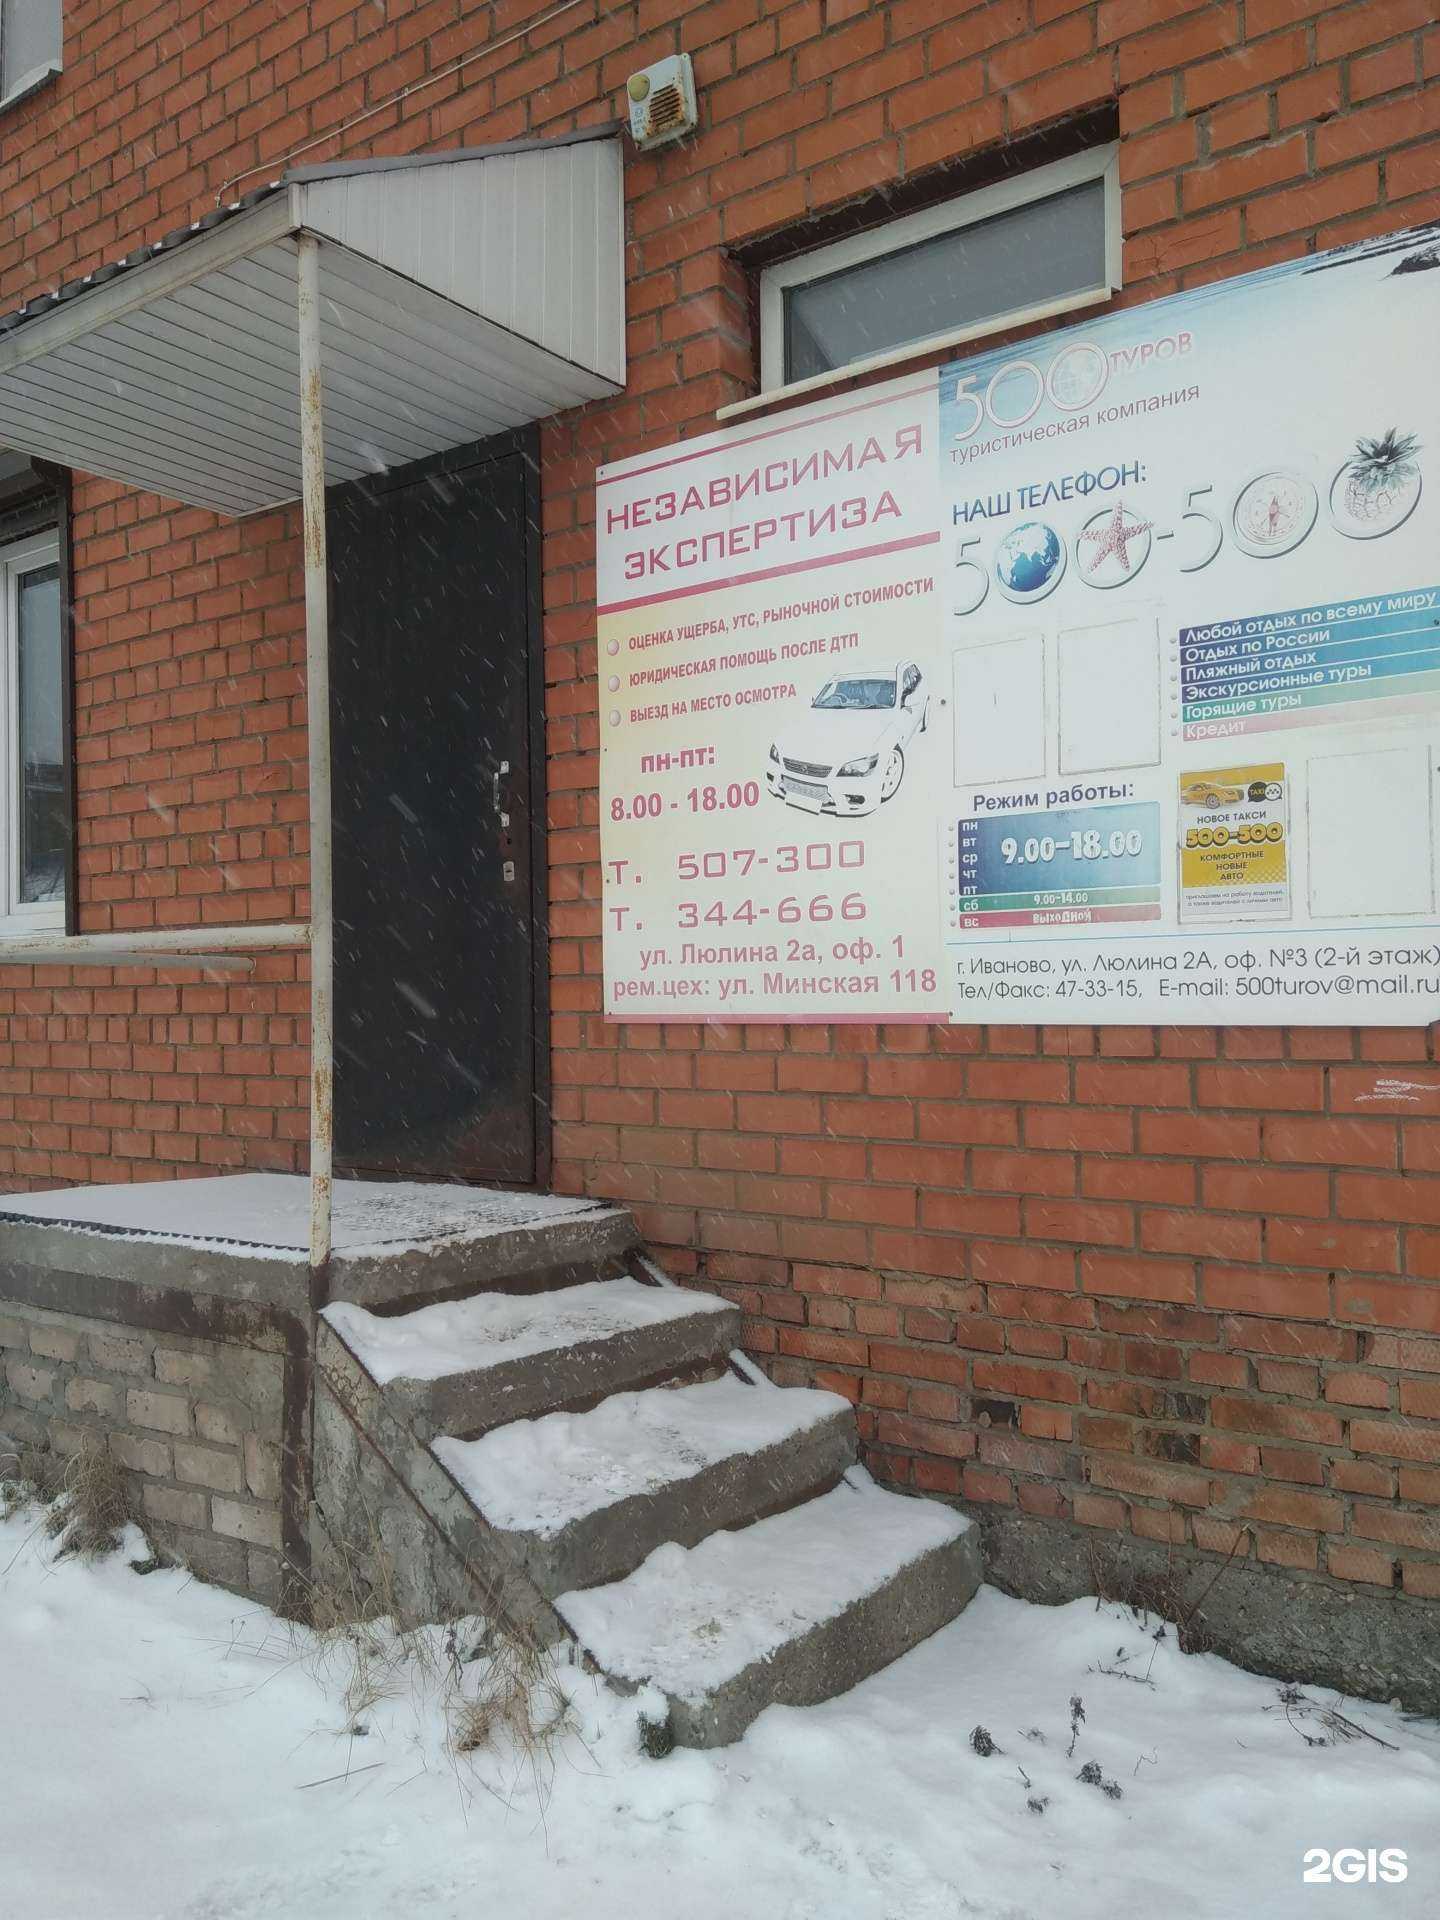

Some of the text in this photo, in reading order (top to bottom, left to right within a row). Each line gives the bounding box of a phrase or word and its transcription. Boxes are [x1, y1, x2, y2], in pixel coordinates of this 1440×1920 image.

[954, 342, 1110, 441] 500
[950, 385, 1200, 465] туристическая компания
[607, 424, 922, 534] НЕЗАВИСИМАЯ
[952, 460, 1147, 525] НАШ ТЕЛЕФОН:
[624, 490, 902, 580] ЭКСПЕРТИЗА
[628, 577, 934, 651] ОЦЕНКА УЩЕРБА, УТС, РЫНОЧНОЙ СТОИМОСТИ
[1185, 591, 1438, 643] Любой отдых по всему миру
[629, 632, 859, 687] ЮРИДИЧЕСКАЯ ПОМОЩЬ ПОСЛЕ ДТП
[1185, 629, 1330, 663] Отдых по России
[1185, 663, 1372, 700] Экскурсионные туры
[1186, 652, 1317, 681] Пляжный отдых
[630, 683, 797, 723] ВЫЕЗД НА МЕСТО ОСМОТРА
[1186, 693, 1302, 720] Горящие туры
[1187, 720, 1247, 739] Кредит
[611, 792, 662, 821] 8.00
[687, 781, 760, 812] 18.00
[973, 782, 1135, 812] Режим работы:
[962, 821, 978, 832] пн
[1197, 811, 1267, 824] НОВОЕ ТАКСИ
[962, 837, 977, 848] вт
[1001, 829, 1143, 865] 9.00-18.00
[1186, 821, 1283, 848] 500-500
[678, 841, 865, 880] 507-300
[962, 853, 978, 866] ср
[1200, 850, 1264, 862] КОМФОРТНЫЕ
[1216, 861, 1248, 871] НОВЫЕ
[962, 869, 978, 879] чт
[1220, 872, 1244, 881] АВТО
[678, 892, 867, 929] 344-666
[963, 899, 979, 911] сб
[964, 918, 979, 927] вс
[640, 935, 904, 971] ул. Люлина 2а, оф. 1
[957, 944, 1440, 976] г. Иваново, ул. Люлина 2А, оф. №3 (2-й этаж)
[613, 968, 937, 1001] рем.цех: ул. Минская 118
[958, 974, 1440, 1000] Тел/Факс: 47-33-15, E-mail: 500turov@mail.ru
